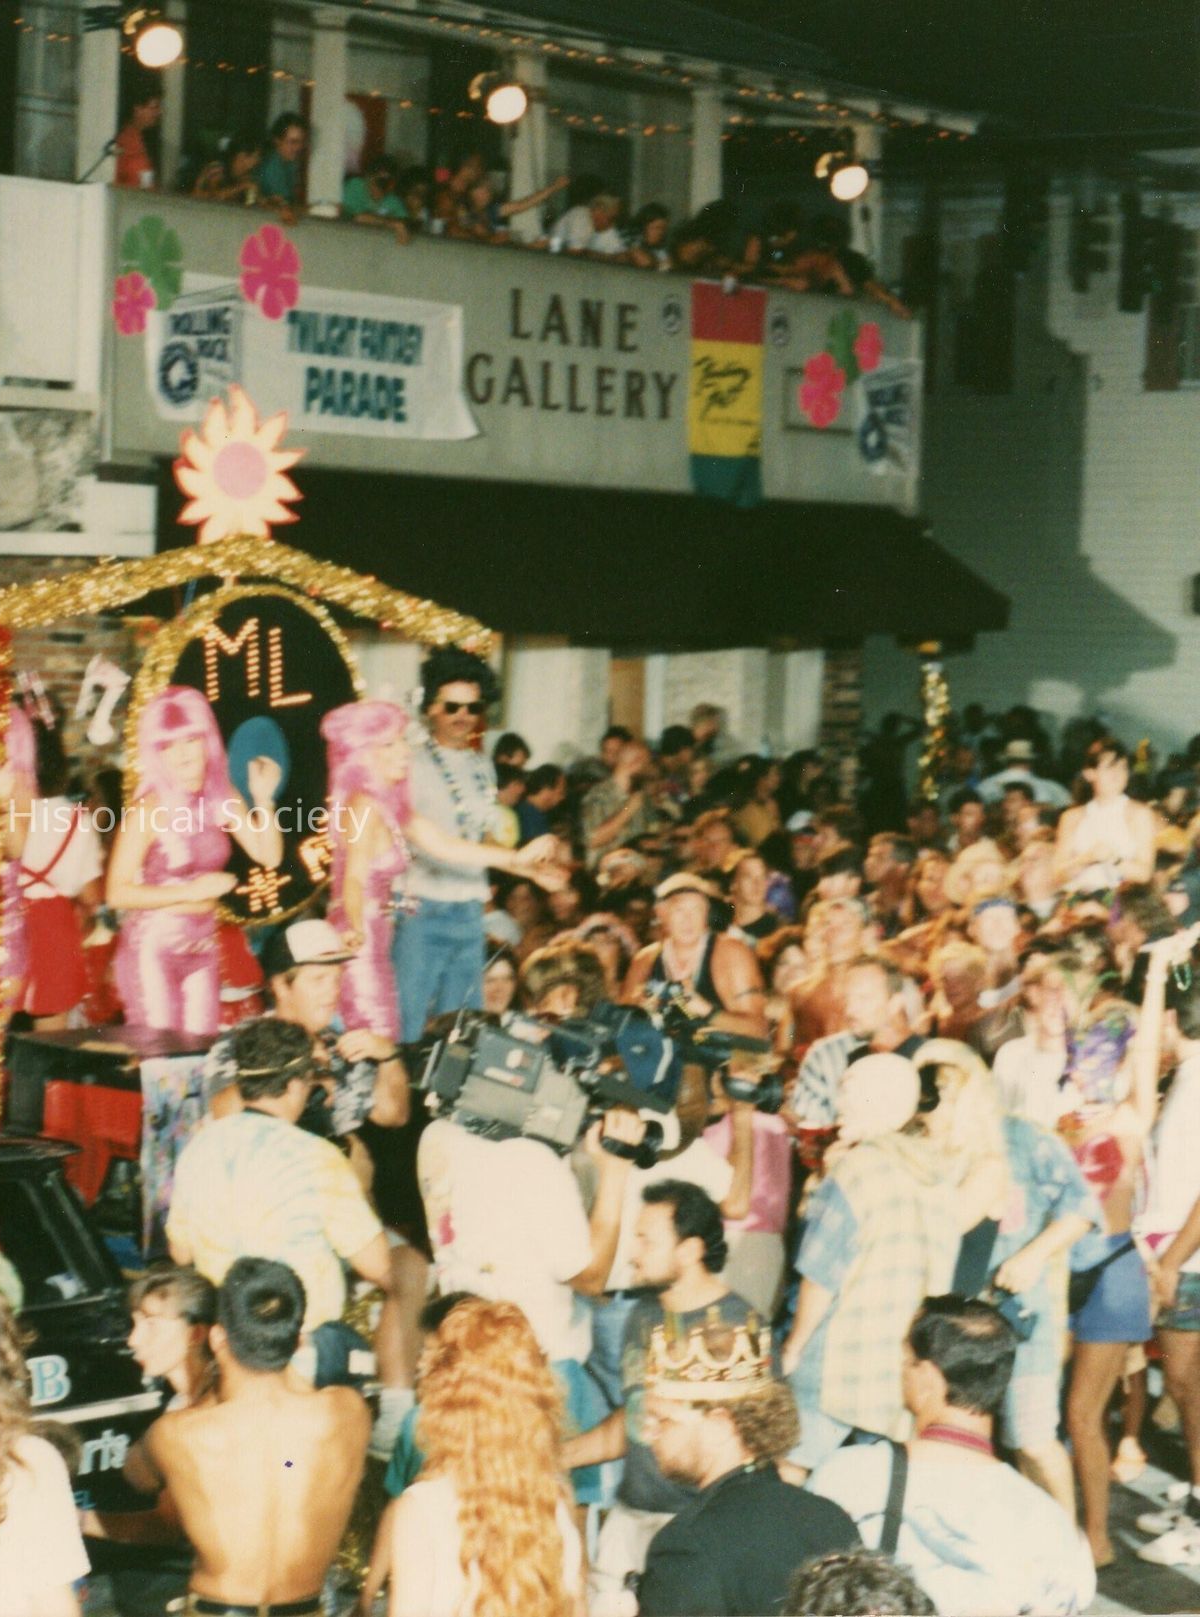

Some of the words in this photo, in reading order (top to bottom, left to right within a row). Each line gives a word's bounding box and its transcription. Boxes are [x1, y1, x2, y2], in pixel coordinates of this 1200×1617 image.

[510, 288, 640, 352] LANE
[303, 365, 407, 424] PARADE
[465, 353, 679, 419] GALLERY
[203, 617, 313, 708] ML
